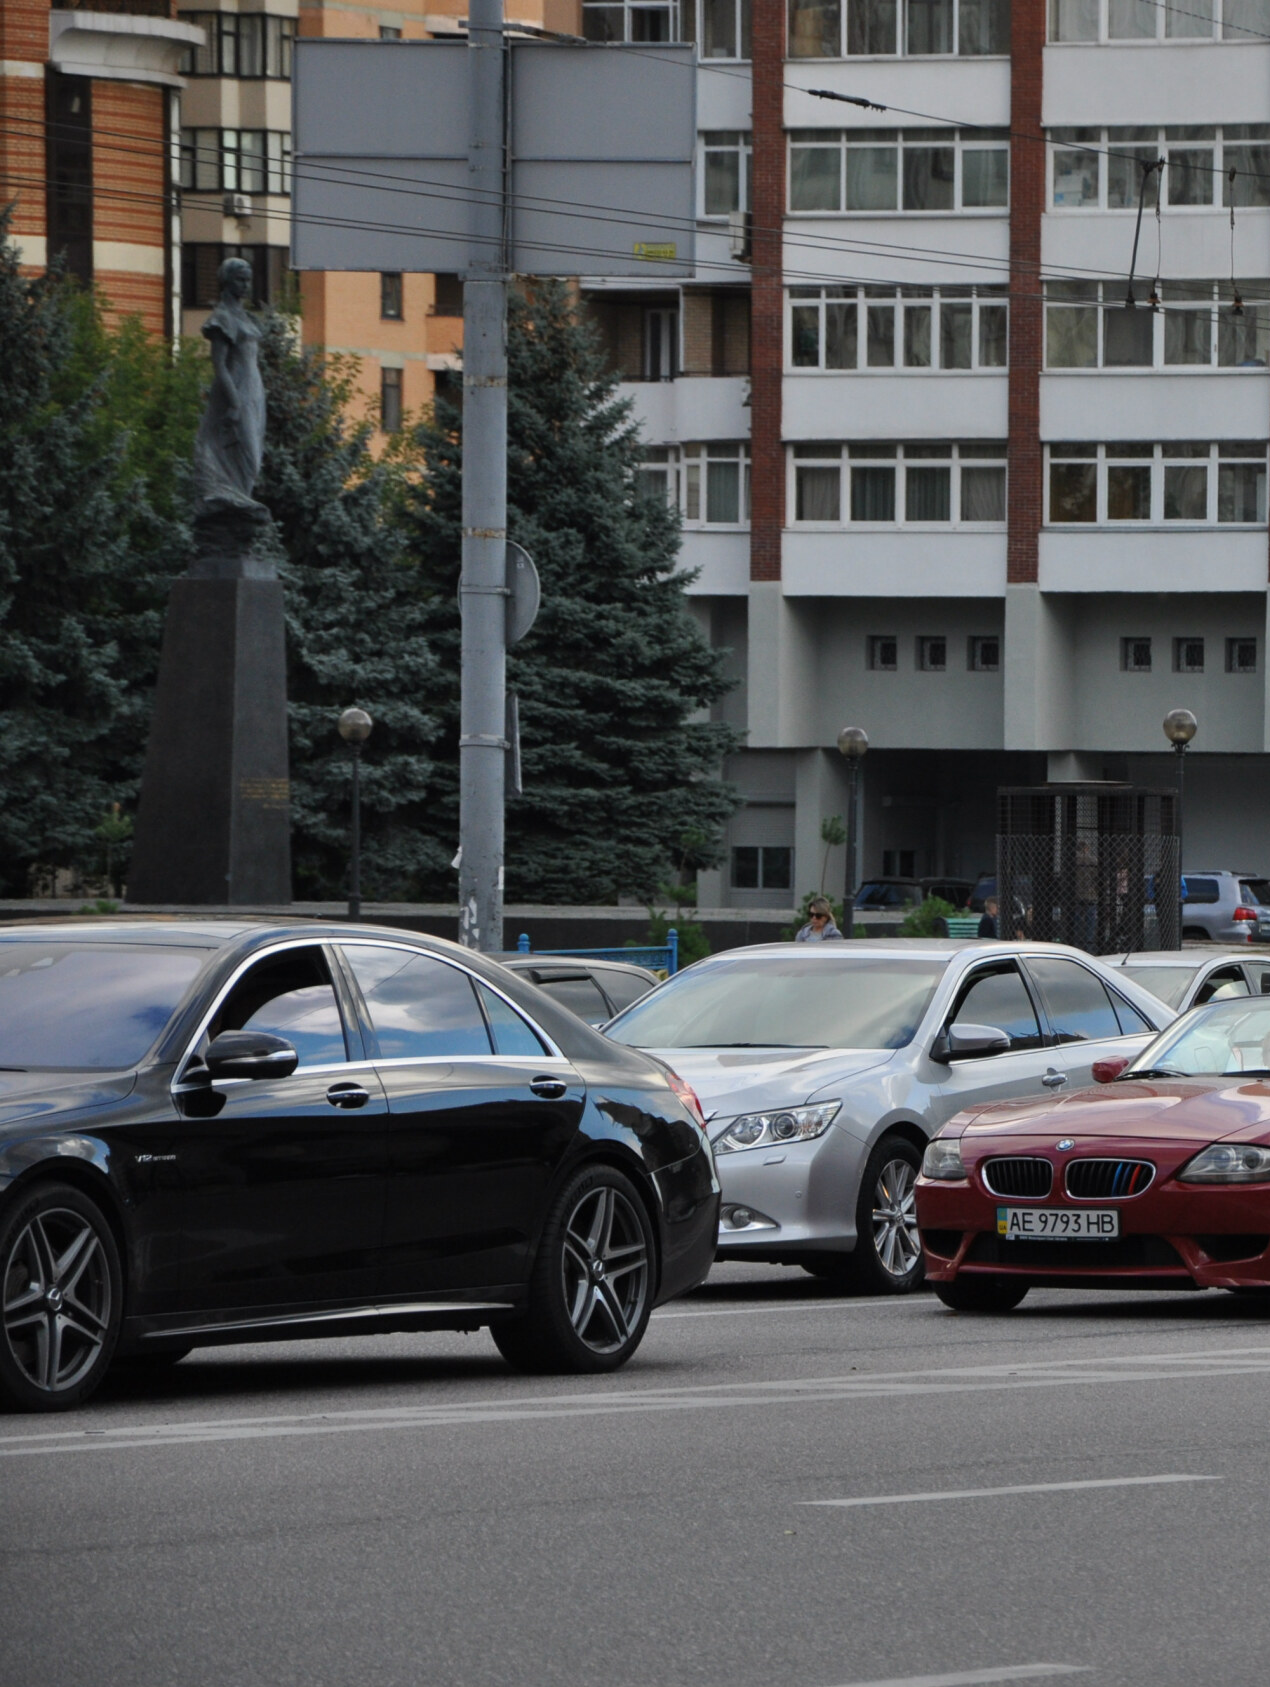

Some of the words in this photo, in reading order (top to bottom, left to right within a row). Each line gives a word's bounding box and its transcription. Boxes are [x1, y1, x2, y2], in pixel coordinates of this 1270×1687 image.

[1009, 1212, 1034, 1232] AE
[1038, 1213, 1081, 1233] 9793
[1086, 1214, 1115, 1234] HB
